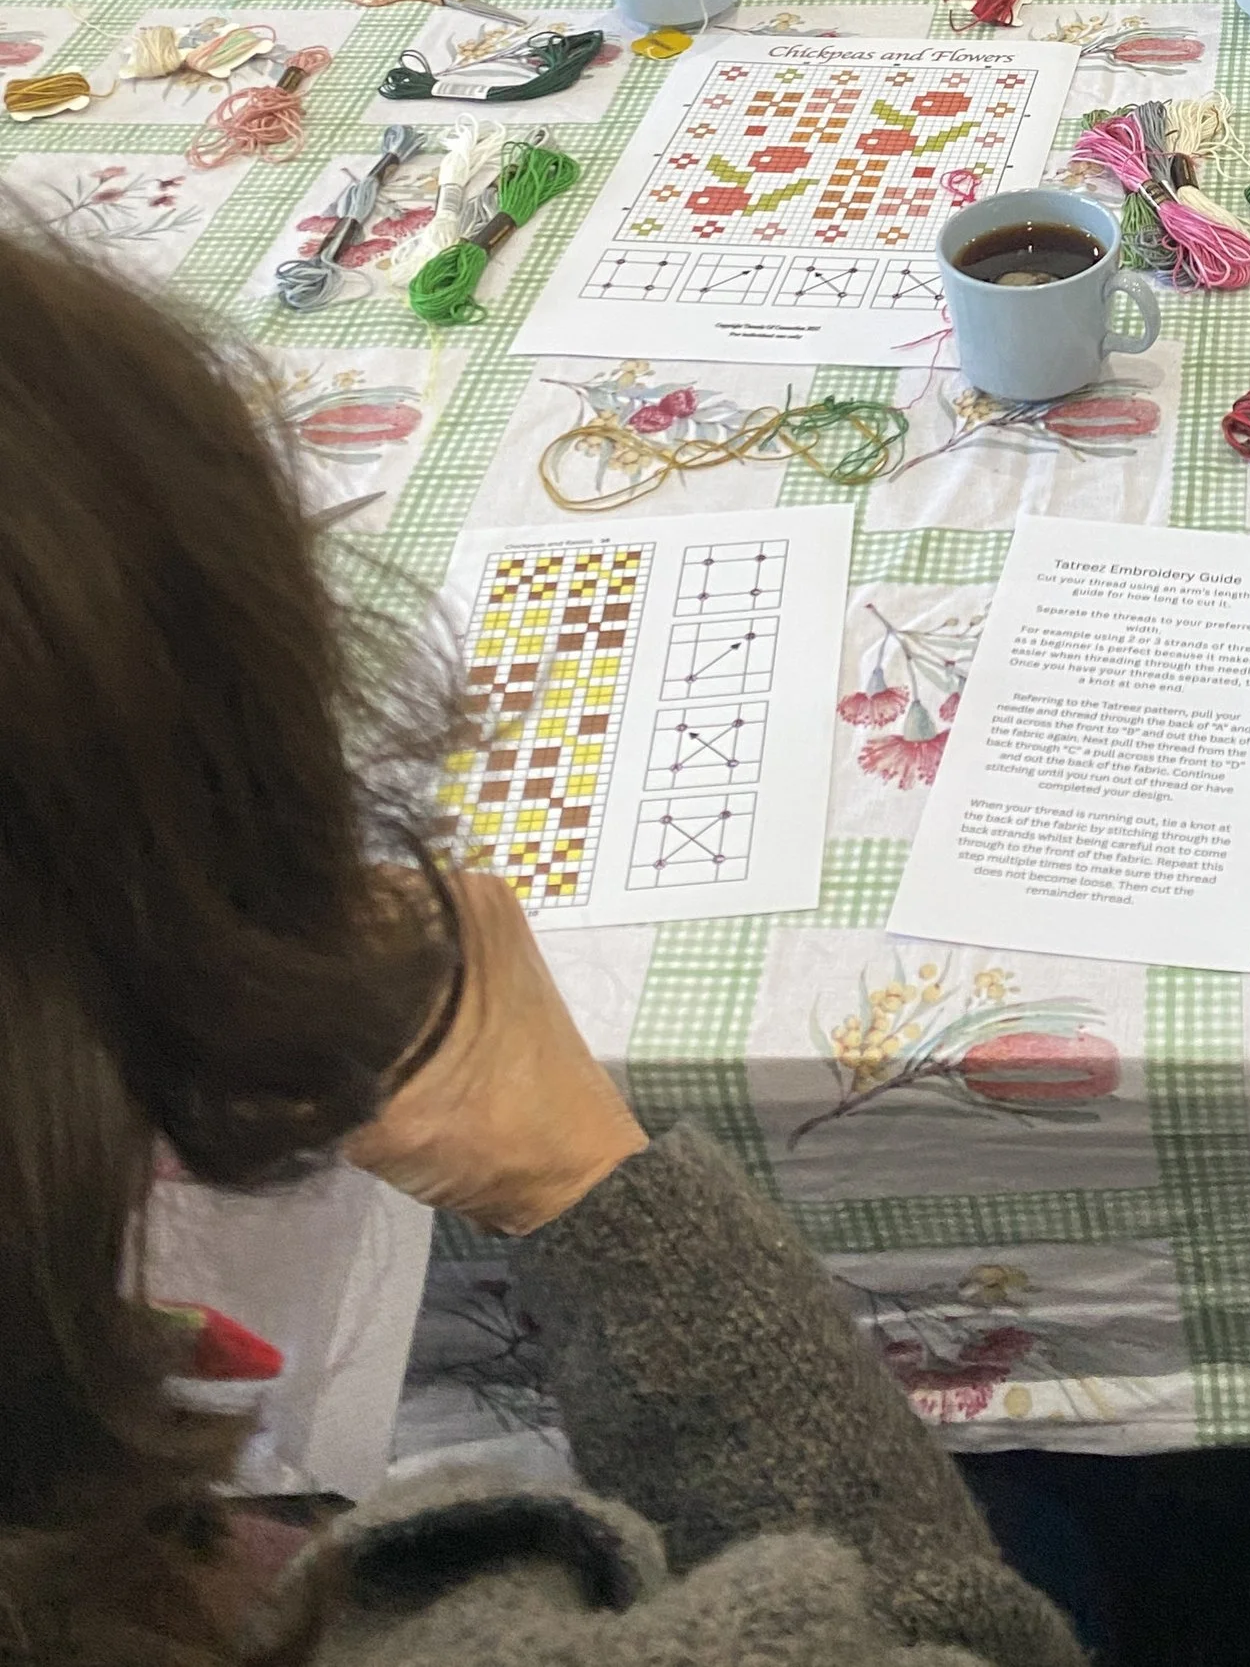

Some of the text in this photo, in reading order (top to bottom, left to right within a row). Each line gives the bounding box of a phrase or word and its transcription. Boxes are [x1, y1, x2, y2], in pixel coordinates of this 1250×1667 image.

[767, 44, 1016, 65] Chickpeas and Flowers
[1054, 558, 1242, 585] Tatreez Embroidery Guide
[1036, 572, 1057, 582] Cut
[1058, 576, 1086, 585] your
[1088, 577, 1127, 589] thread
[1128, 582, 1160, 593] using
[1162, 585, 1176, 593] an
[1213, 588, 1250, 600] length
[1071, 587, 1104, 597] guide
[1106, 589, 1124, 598] for
[1126, 591, 1151, 601] how
[1153, 593, 1179, 605] long
[1181, 596, 1194, 605] to
[1196, 598, 1215, 606] cut
[1036, 604, 1087, 616] Separate
[1090, 609, 1110, 619] the
[1112, 612, 1157, 623] threads
[1159, 616, 1173, 625] to
[1174, 618, 1202, 627] your
[1037, 781, 1101, 794] completed
[1101, 787, 1131, 797] your
[969, 798, 1003, 810] When
[1003, 803, 1033, 813] your
[1034, 805, 1074, 818] thread
[1074, 809, 1085, 819] is
[1087, 811, 1133, 826] running
[1161, 817, 1178, 827] tie
[1178, 820, 1187, 829] a
[1189, 820, 1216, 831] knot
[1217, 823, 1231, 833] at
[963, 810, 1231, 846] the back of the fabric by stitching through the
[1025, 885, 1089, 899] remainder
